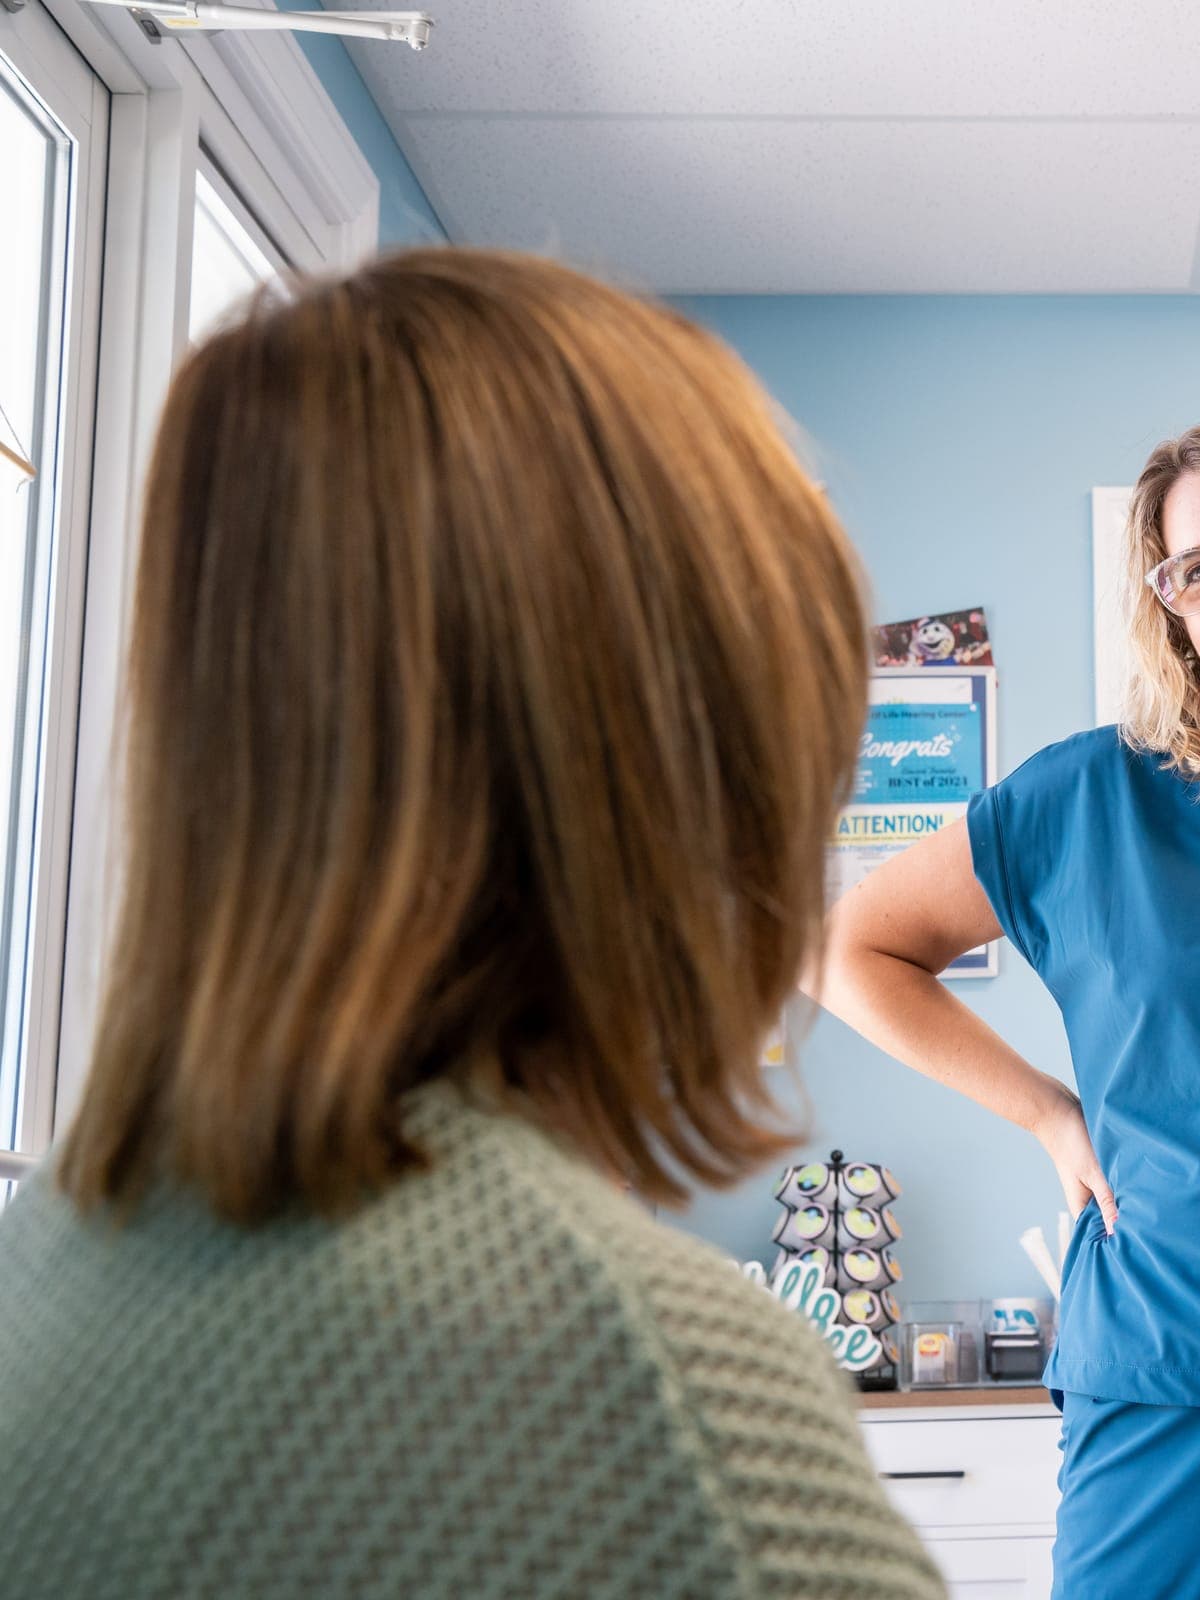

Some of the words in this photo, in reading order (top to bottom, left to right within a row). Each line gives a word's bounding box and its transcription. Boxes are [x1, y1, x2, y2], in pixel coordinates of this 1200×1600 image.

[901, 709, 936, 720] Hearing
[859, 732, 953, 767] Congrats
[888, 777, 919, 788] BEST
[922, 776, 936, 788] of
[838, 814, 943, 834] ATTENTION!
